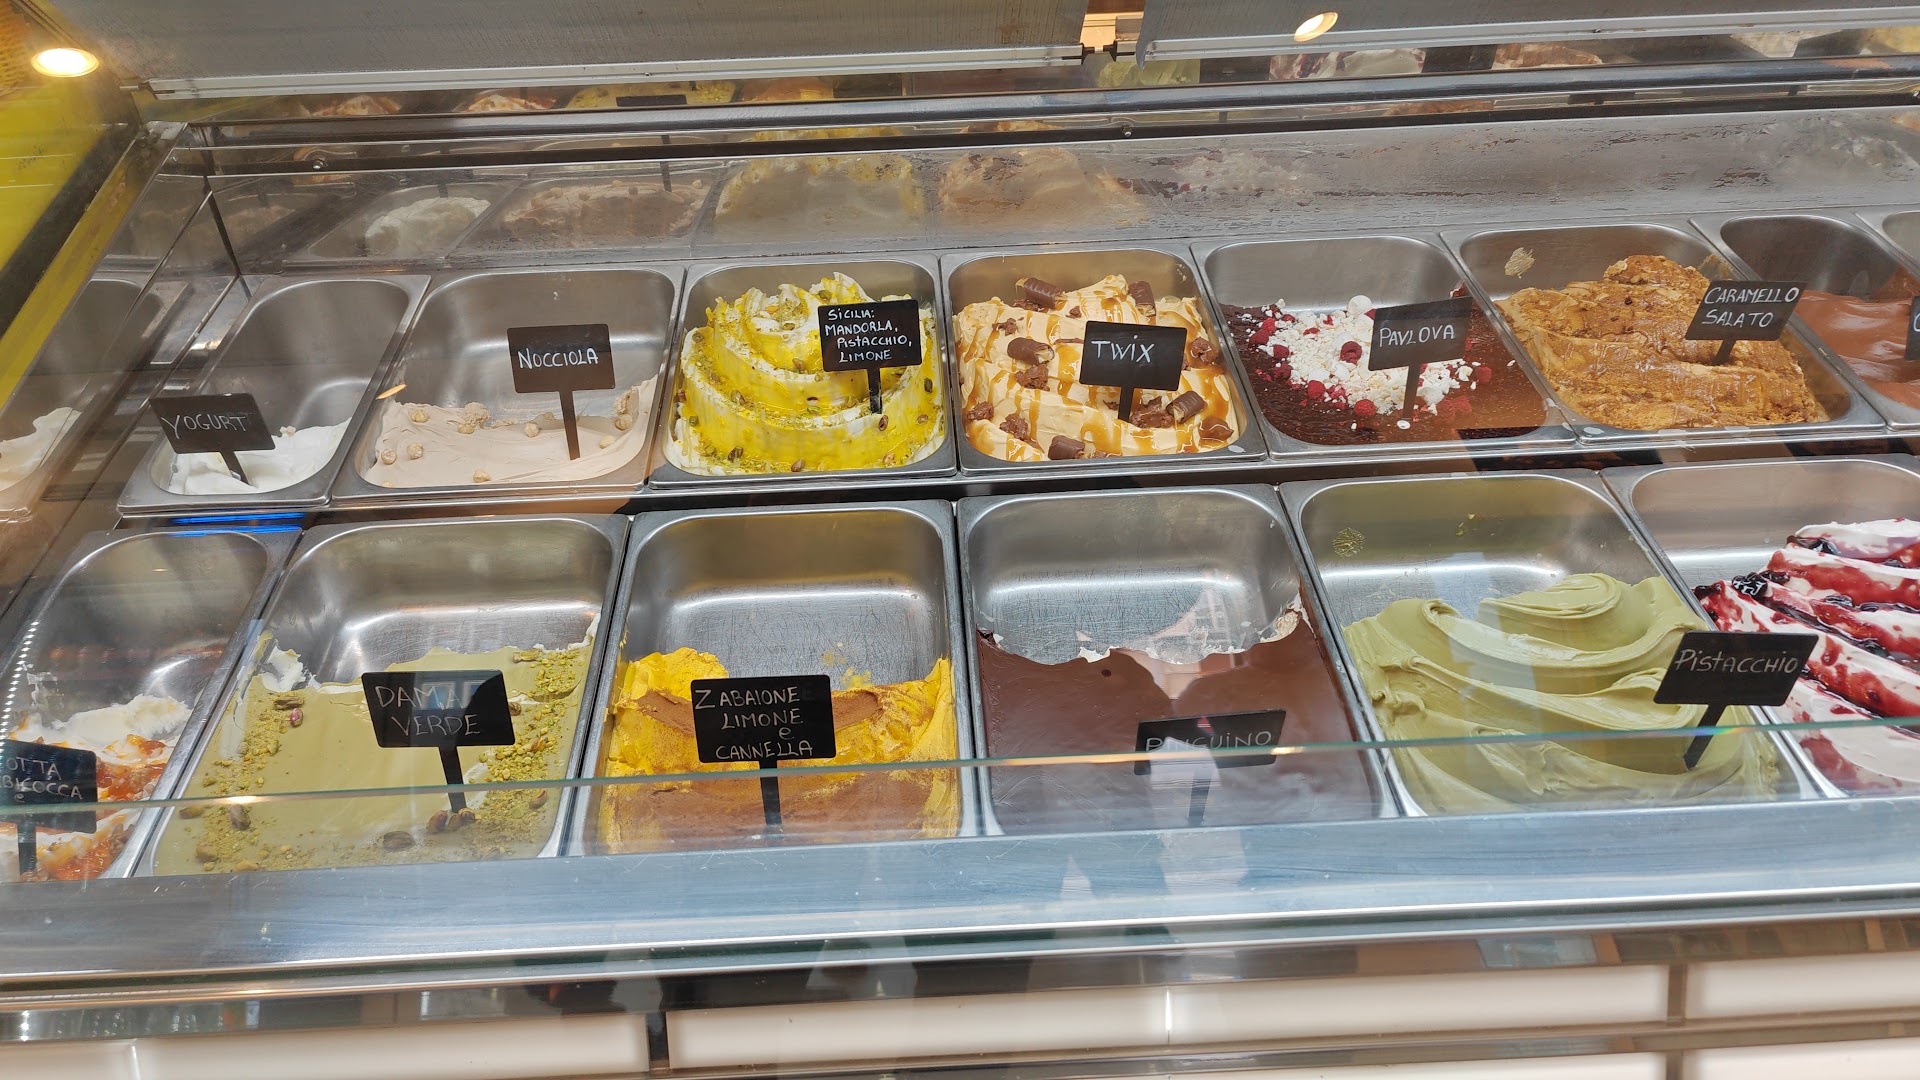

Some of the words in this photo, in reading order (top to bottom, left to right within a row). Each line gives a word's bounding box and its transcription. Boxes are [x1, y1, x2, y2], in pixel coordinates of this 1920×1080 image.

[1702, 286, 1800, 304] CARAMELLO
[824, 319, 898, 337] MANDORLA,
[1701, 308, 1774, 328] SALATO
[1379, 324, 1456, 348] PAVLOVA
[517, 347, 599, 370] NOCCIOLA
[838, 349, 892, 363] LIMONE
[160, 413, 247, 440] YOGURT
[694, 686, 801, 710] ZABAIONE
[390, 714, 481, 736] VERDE
[720, 708, 804, 730] LIMONE
[715, 739, 813, 760] CANNELLA
[6, 756, 62, 780] OTTA
[1, 774, 83, 800] BICOCCA
